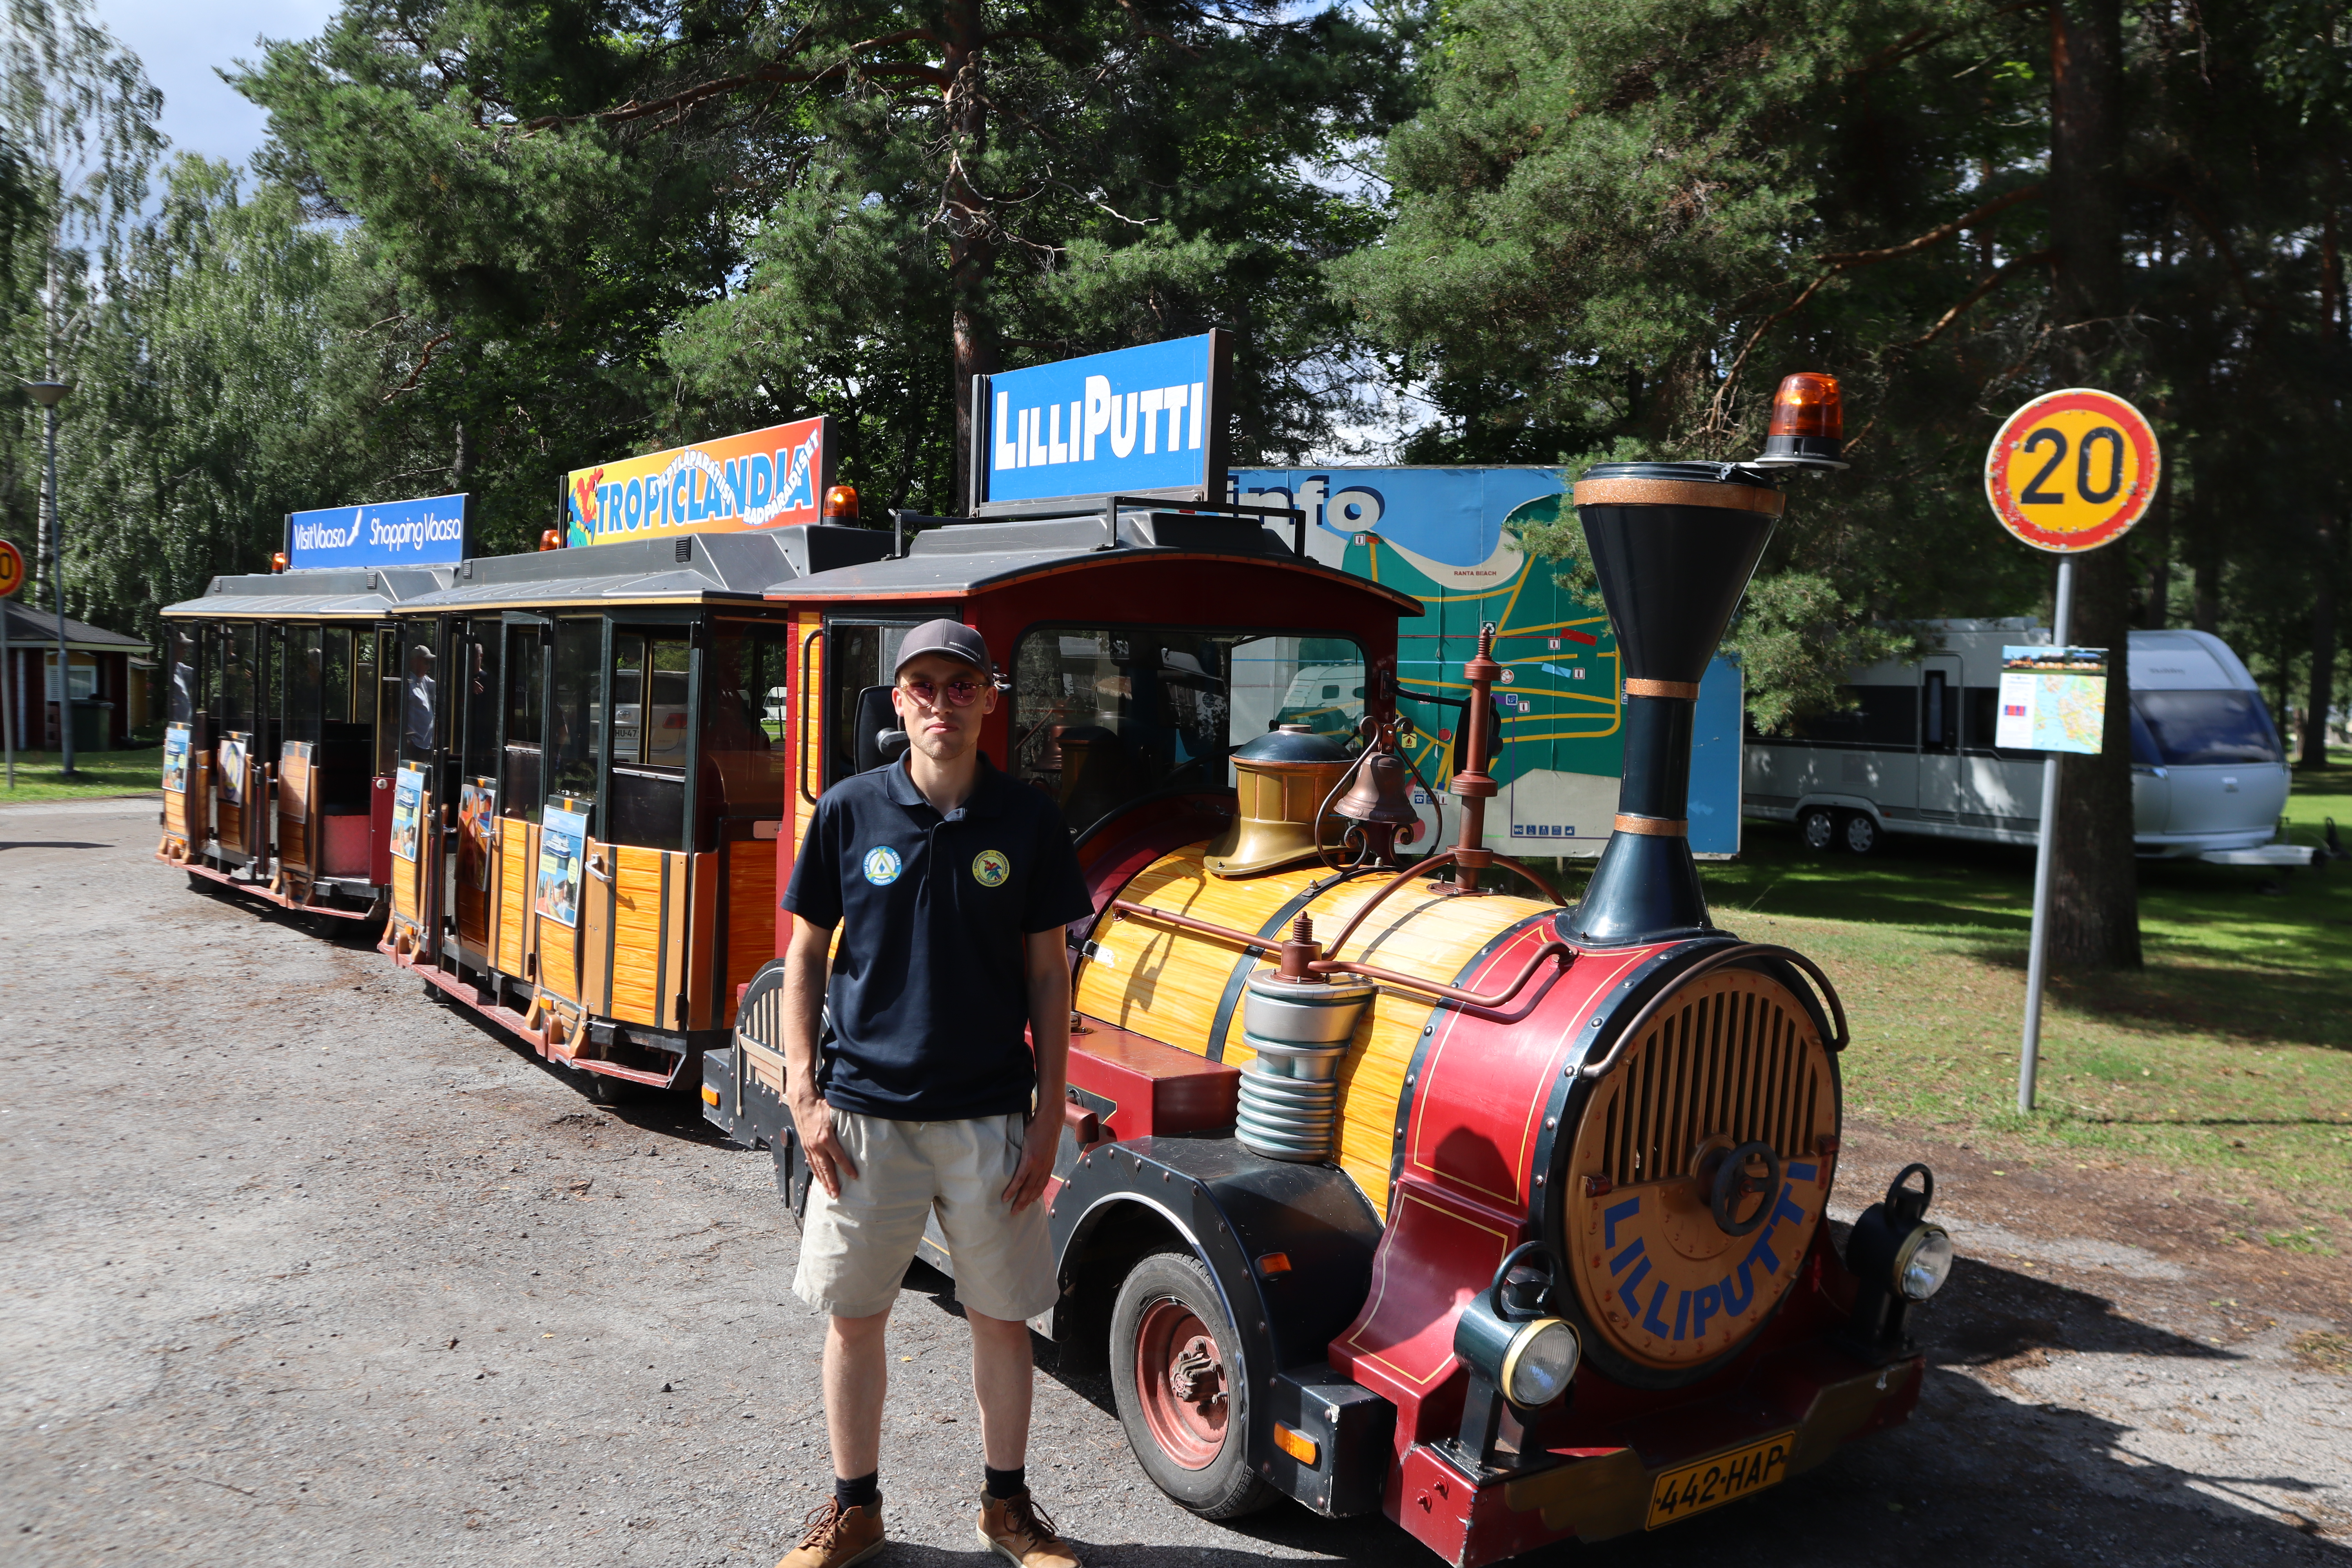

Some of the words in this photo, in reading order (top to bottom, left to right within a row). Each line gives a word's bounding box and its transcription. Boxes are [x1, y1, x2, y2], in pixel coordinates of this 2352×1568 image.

[995, 375, 1204, 470] LILLIPUTTI
[595, 445, 814, 535] TROPICLANDIA
[650, 446, 734, 505] KYLPYLÄPARATIISI
[742, 427, 819, 526] BADPARADISET
[2020, 426, 2124, 505] 20
[1226, 475, 1385, 532] info
[949, 641, 981, 659] messuvaunu.fi
[615, 729, 639, 737] HU-47
[864, 849, 877, 865] CAMPING
[892, 851, 900, 866] VAASA
[976, 875, 1001, 885] TROPICLANDIA
[996, 852, 1008, 874] VATTENPARK
[1604, 1161, 1818, 1341] LILLIPUTTI
[1658, 1444, 1784, 1514] 442-HAP
